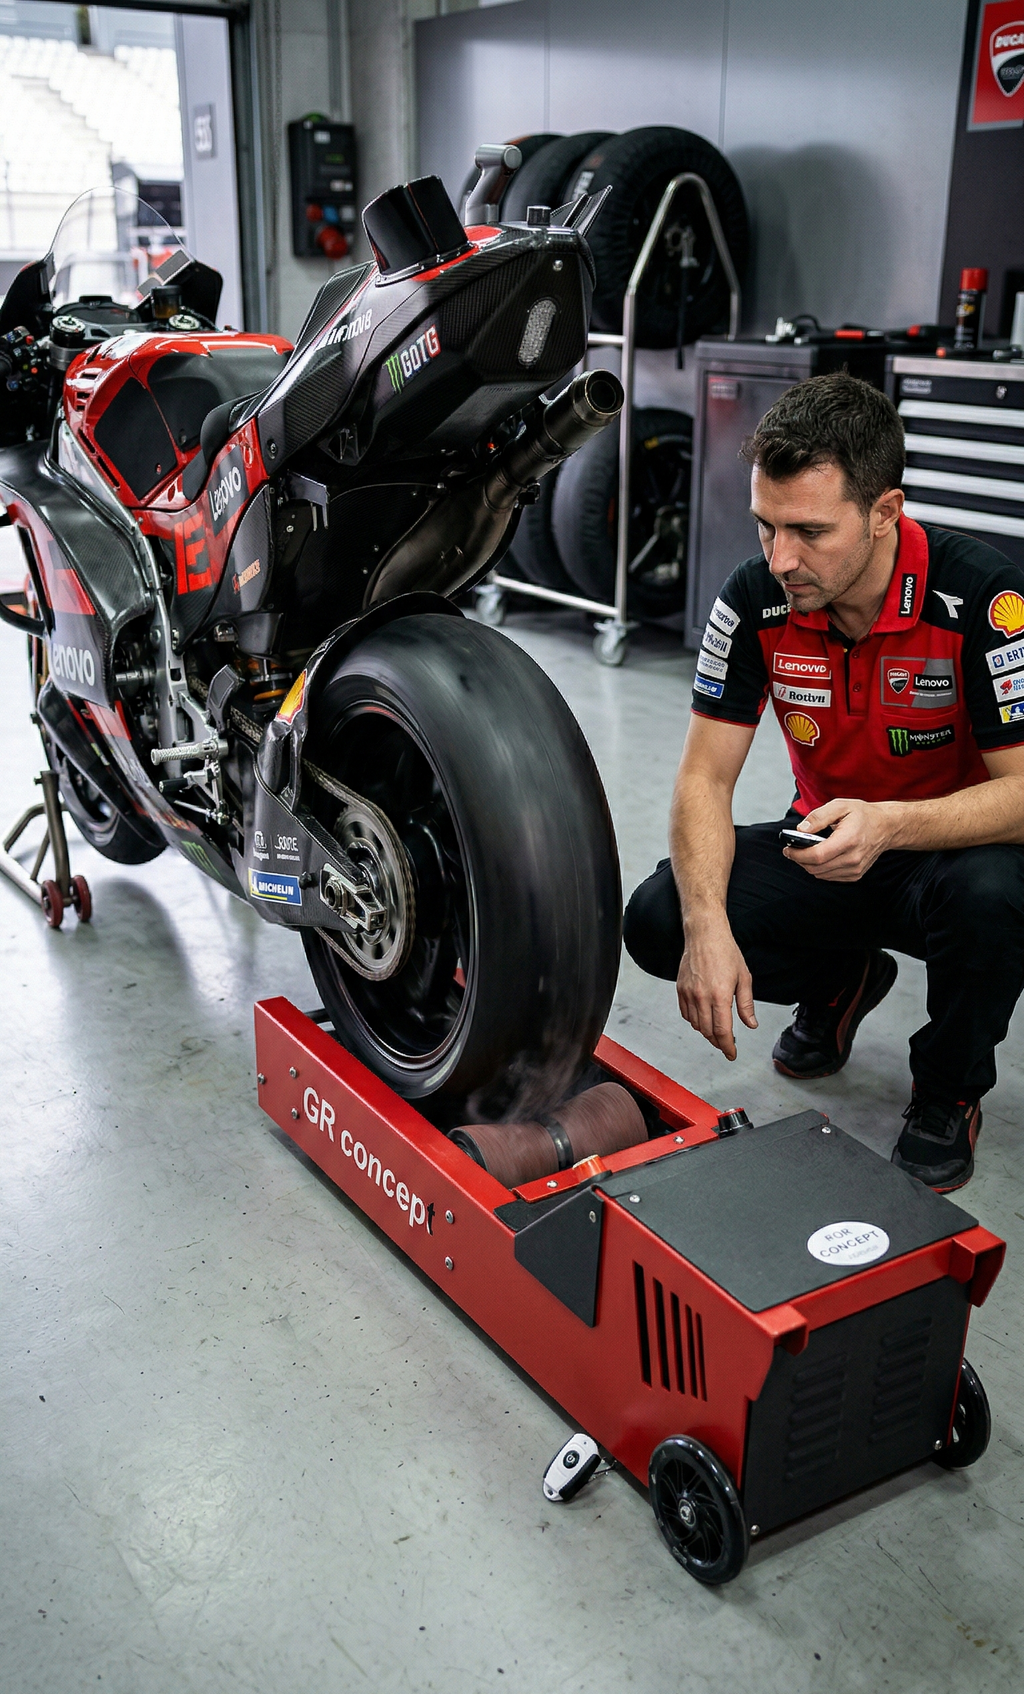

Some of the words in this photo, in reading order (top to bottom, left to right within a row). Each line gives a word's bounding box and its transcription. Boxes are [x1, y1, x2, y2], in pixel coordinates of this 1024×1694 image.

[900, 576, 914, 614] Lenovo
[915, 676, 950, 688] Lenovo
[258, 881, 294, 896] MICHELIN
[303, 1086, 335, 1143] GR
[340, 1129, 436, 1236] concept
[819, 1230, 880, 1258] CONCEPT
